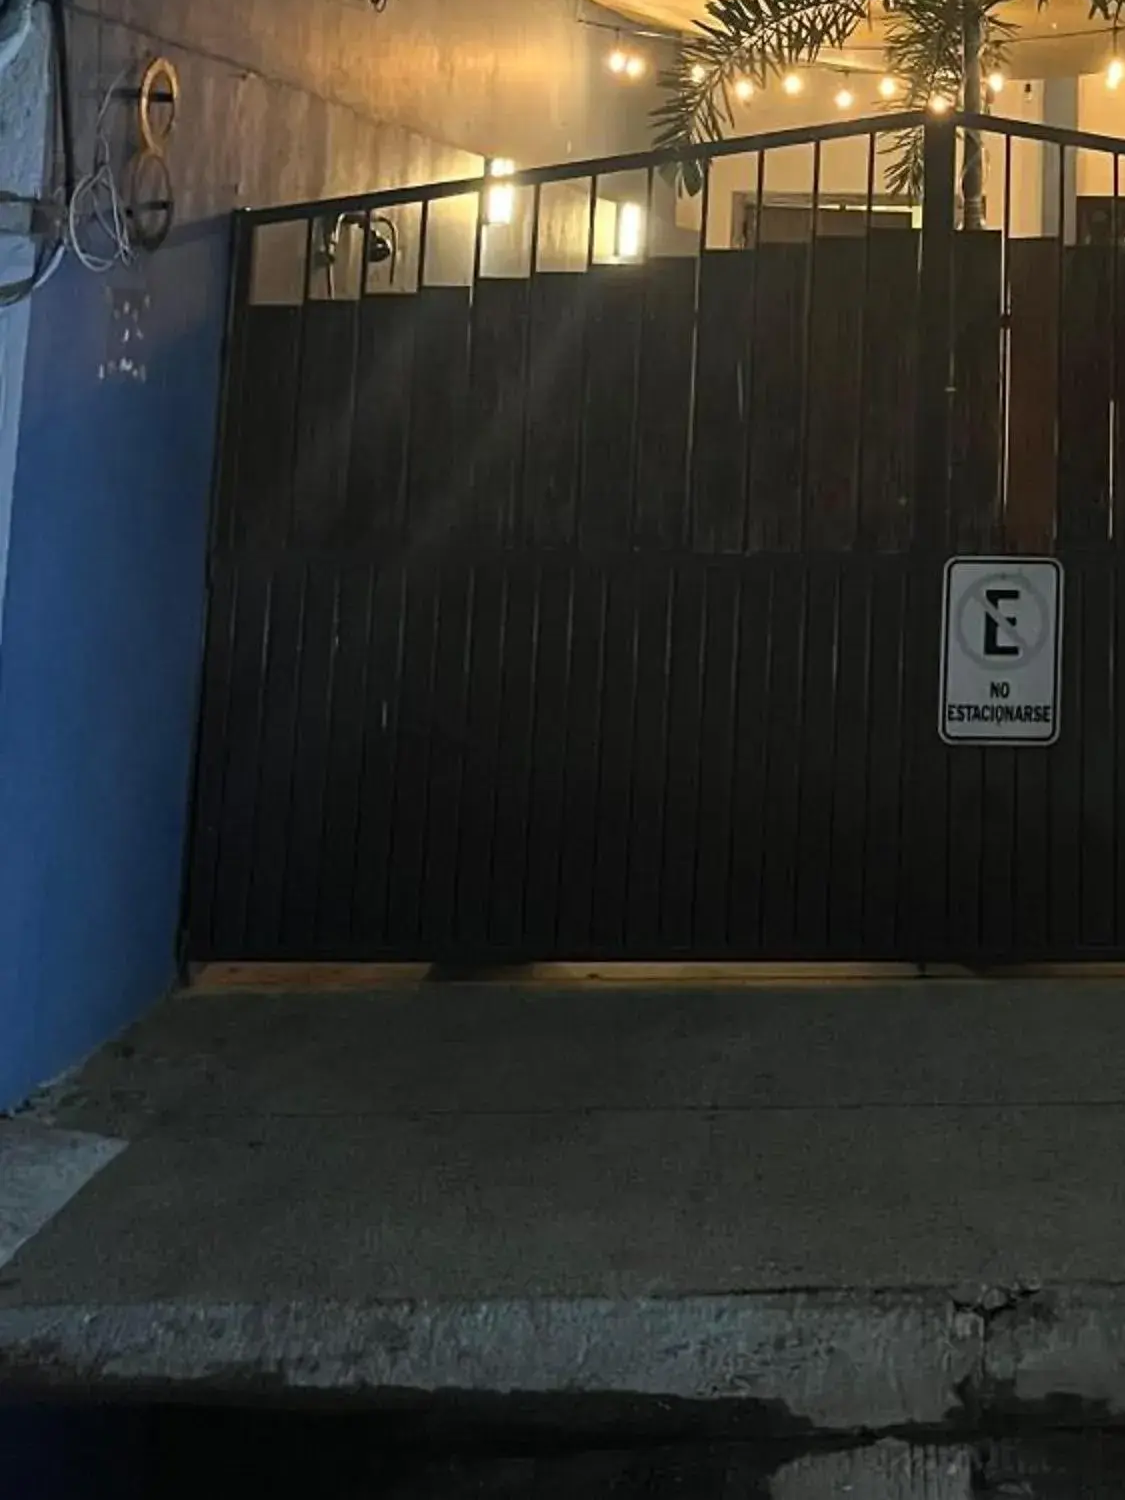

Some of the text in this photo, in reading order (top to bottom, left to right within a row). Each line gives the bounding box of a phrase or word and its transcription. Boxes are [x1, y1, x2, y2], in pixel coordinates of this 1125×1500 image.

[983, 589, 1020, 656] E
[989, 682, 1010, 698] NO
[947, 704, 1051, 722] ESTACIONARSE
